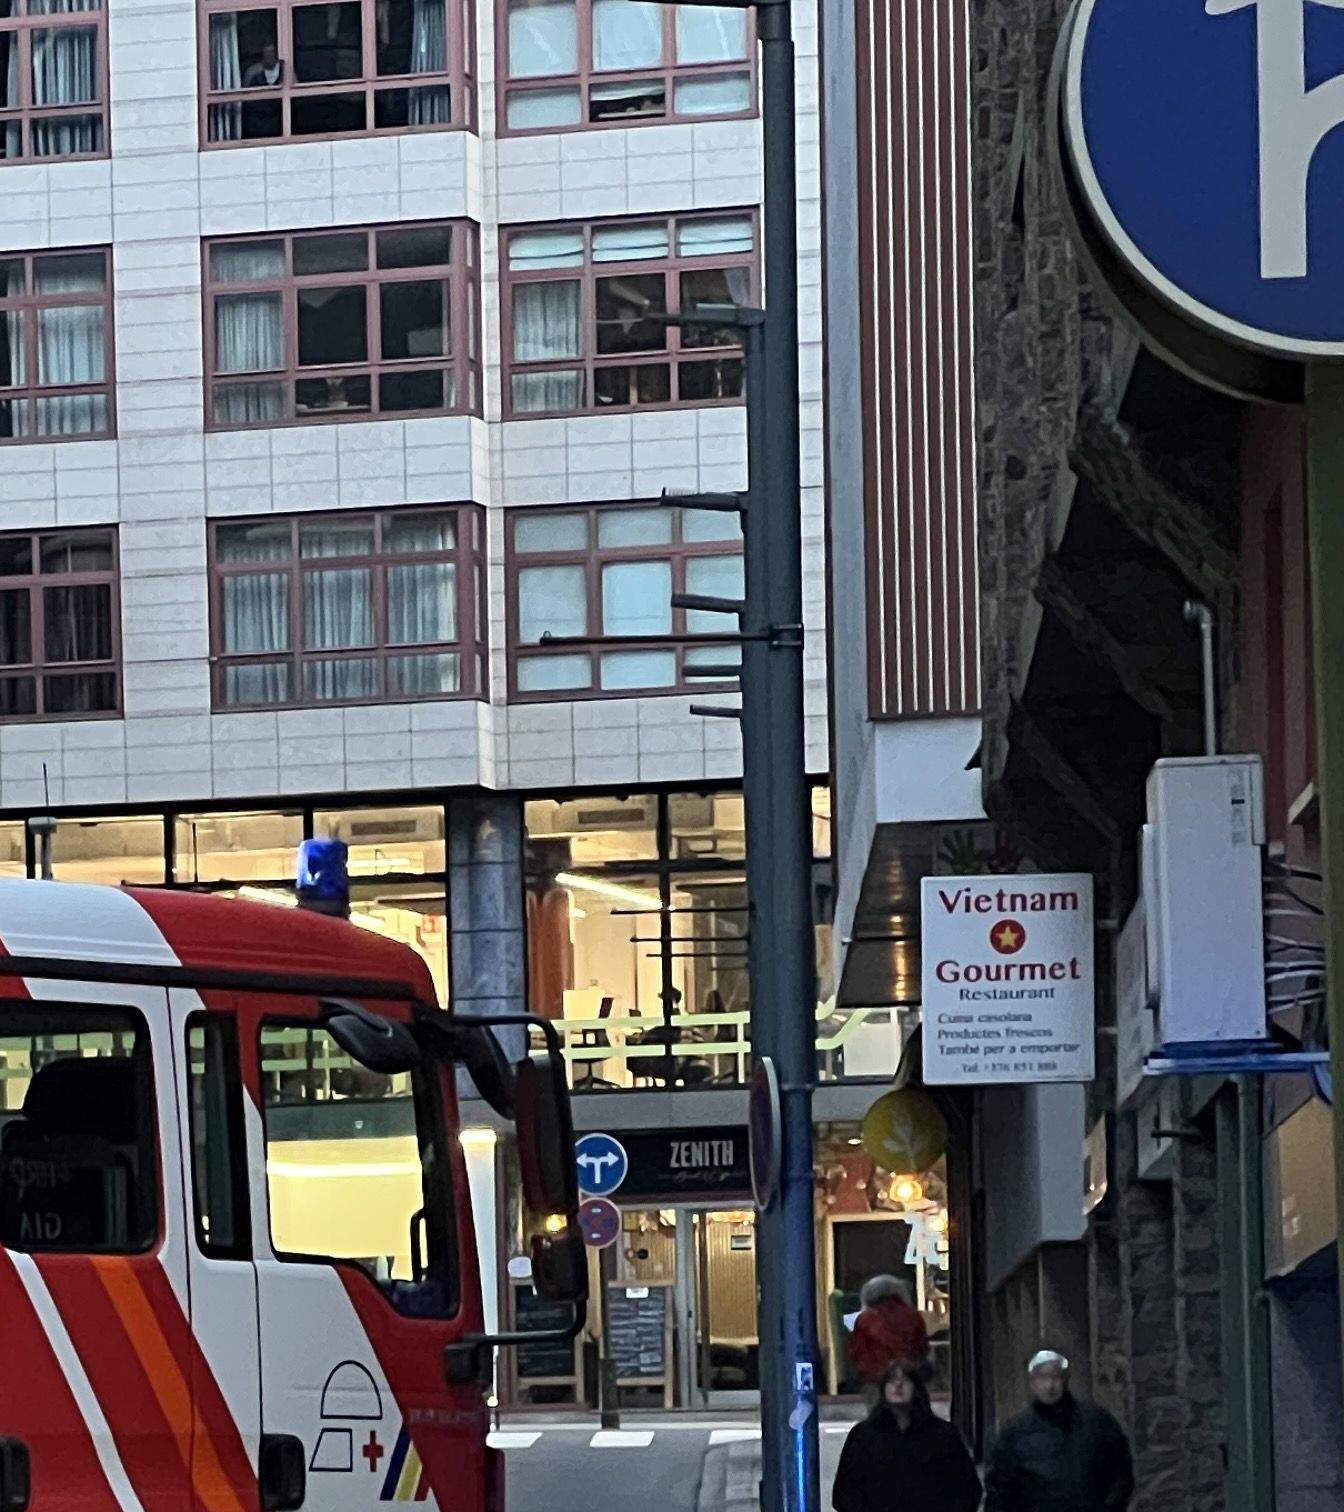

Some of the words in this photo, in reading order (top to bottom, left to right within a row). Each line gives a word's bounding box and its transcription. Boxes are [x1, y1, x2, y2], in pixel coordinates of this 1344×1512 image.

[938, 887, 1079, 914] Vietnam
[935, 957, 1082, 983] Gourmet
[959, 987, 1056, 1001] Restaurant
[937, 1028, 1001, 1040] Productes
[984, 1045, 1005, 1057] per
[669, 1140, 734, 1168] ZENITH
